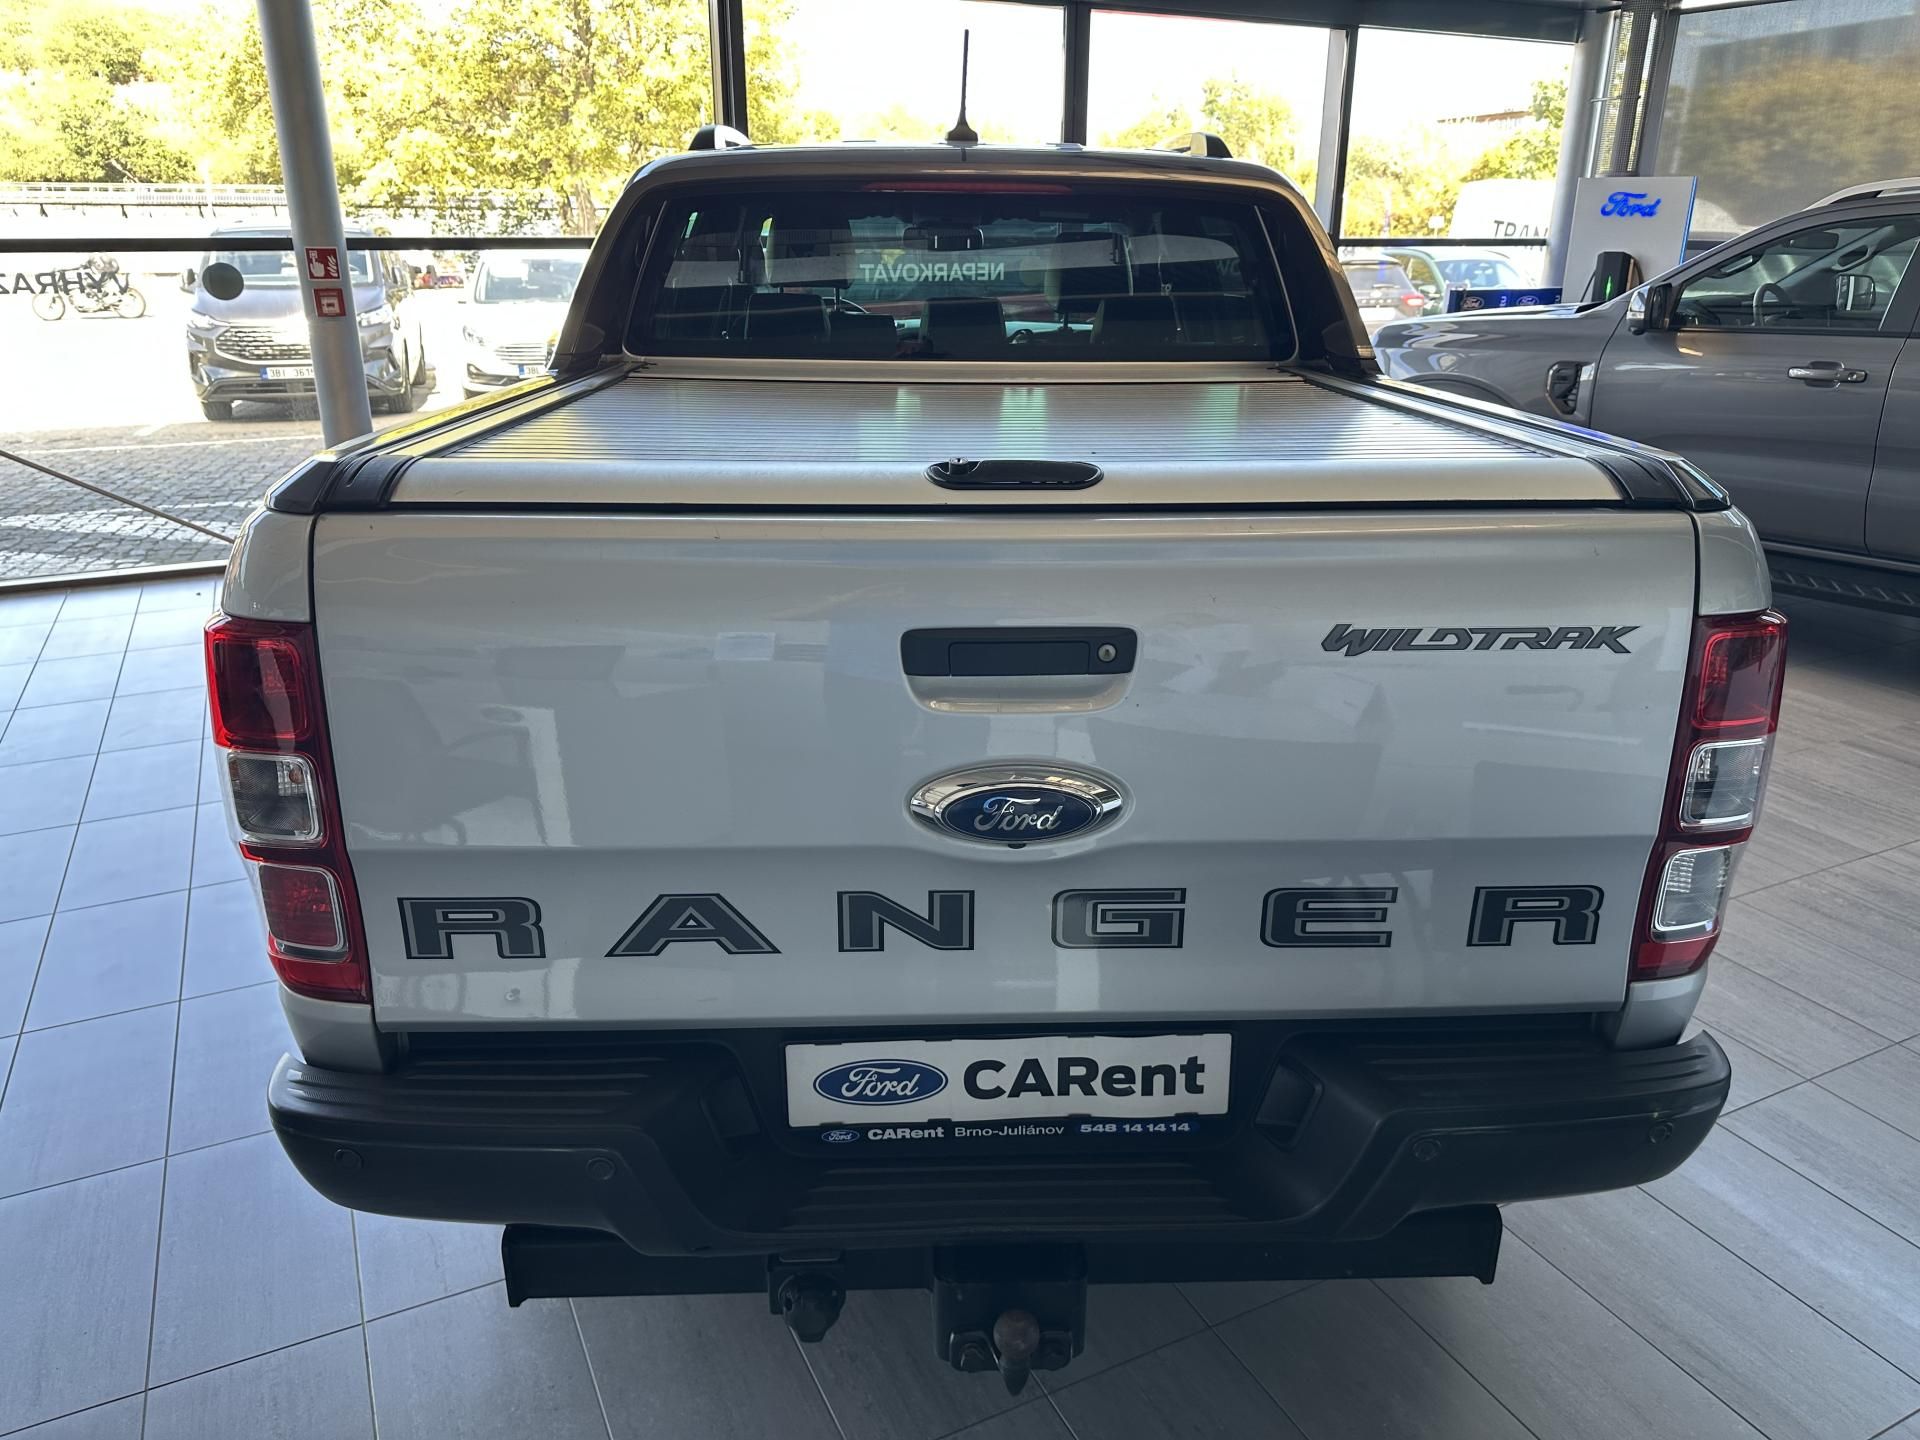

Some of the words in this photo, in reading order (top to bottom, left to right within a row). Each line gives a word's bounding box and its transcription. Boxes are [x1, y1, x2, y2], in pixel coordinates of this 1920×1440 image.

[1600, 191, 1662, 217] Ford
[1321, 624, 1640, 656] WILDTRAK
[973, 796, 1063, 831] Ford
[397, 885, 1605, 960] RANGER
[841, 1067, 921, 1097] Ford
[963, 1055, 1206, 1100] CARent
[828, 1131, 852, 1141] Ford
[867, 1127, 944, 1140] CARent
[954, 1123, 1065, 1137] Brno-Juliánov
[1080, 1123, 1117, 1133] 548
[1123, 1123, 1143, 1133] 14
[1146, 1123, 1167, 1132] 14
[1169, 1122, 1191, 1132] 14
